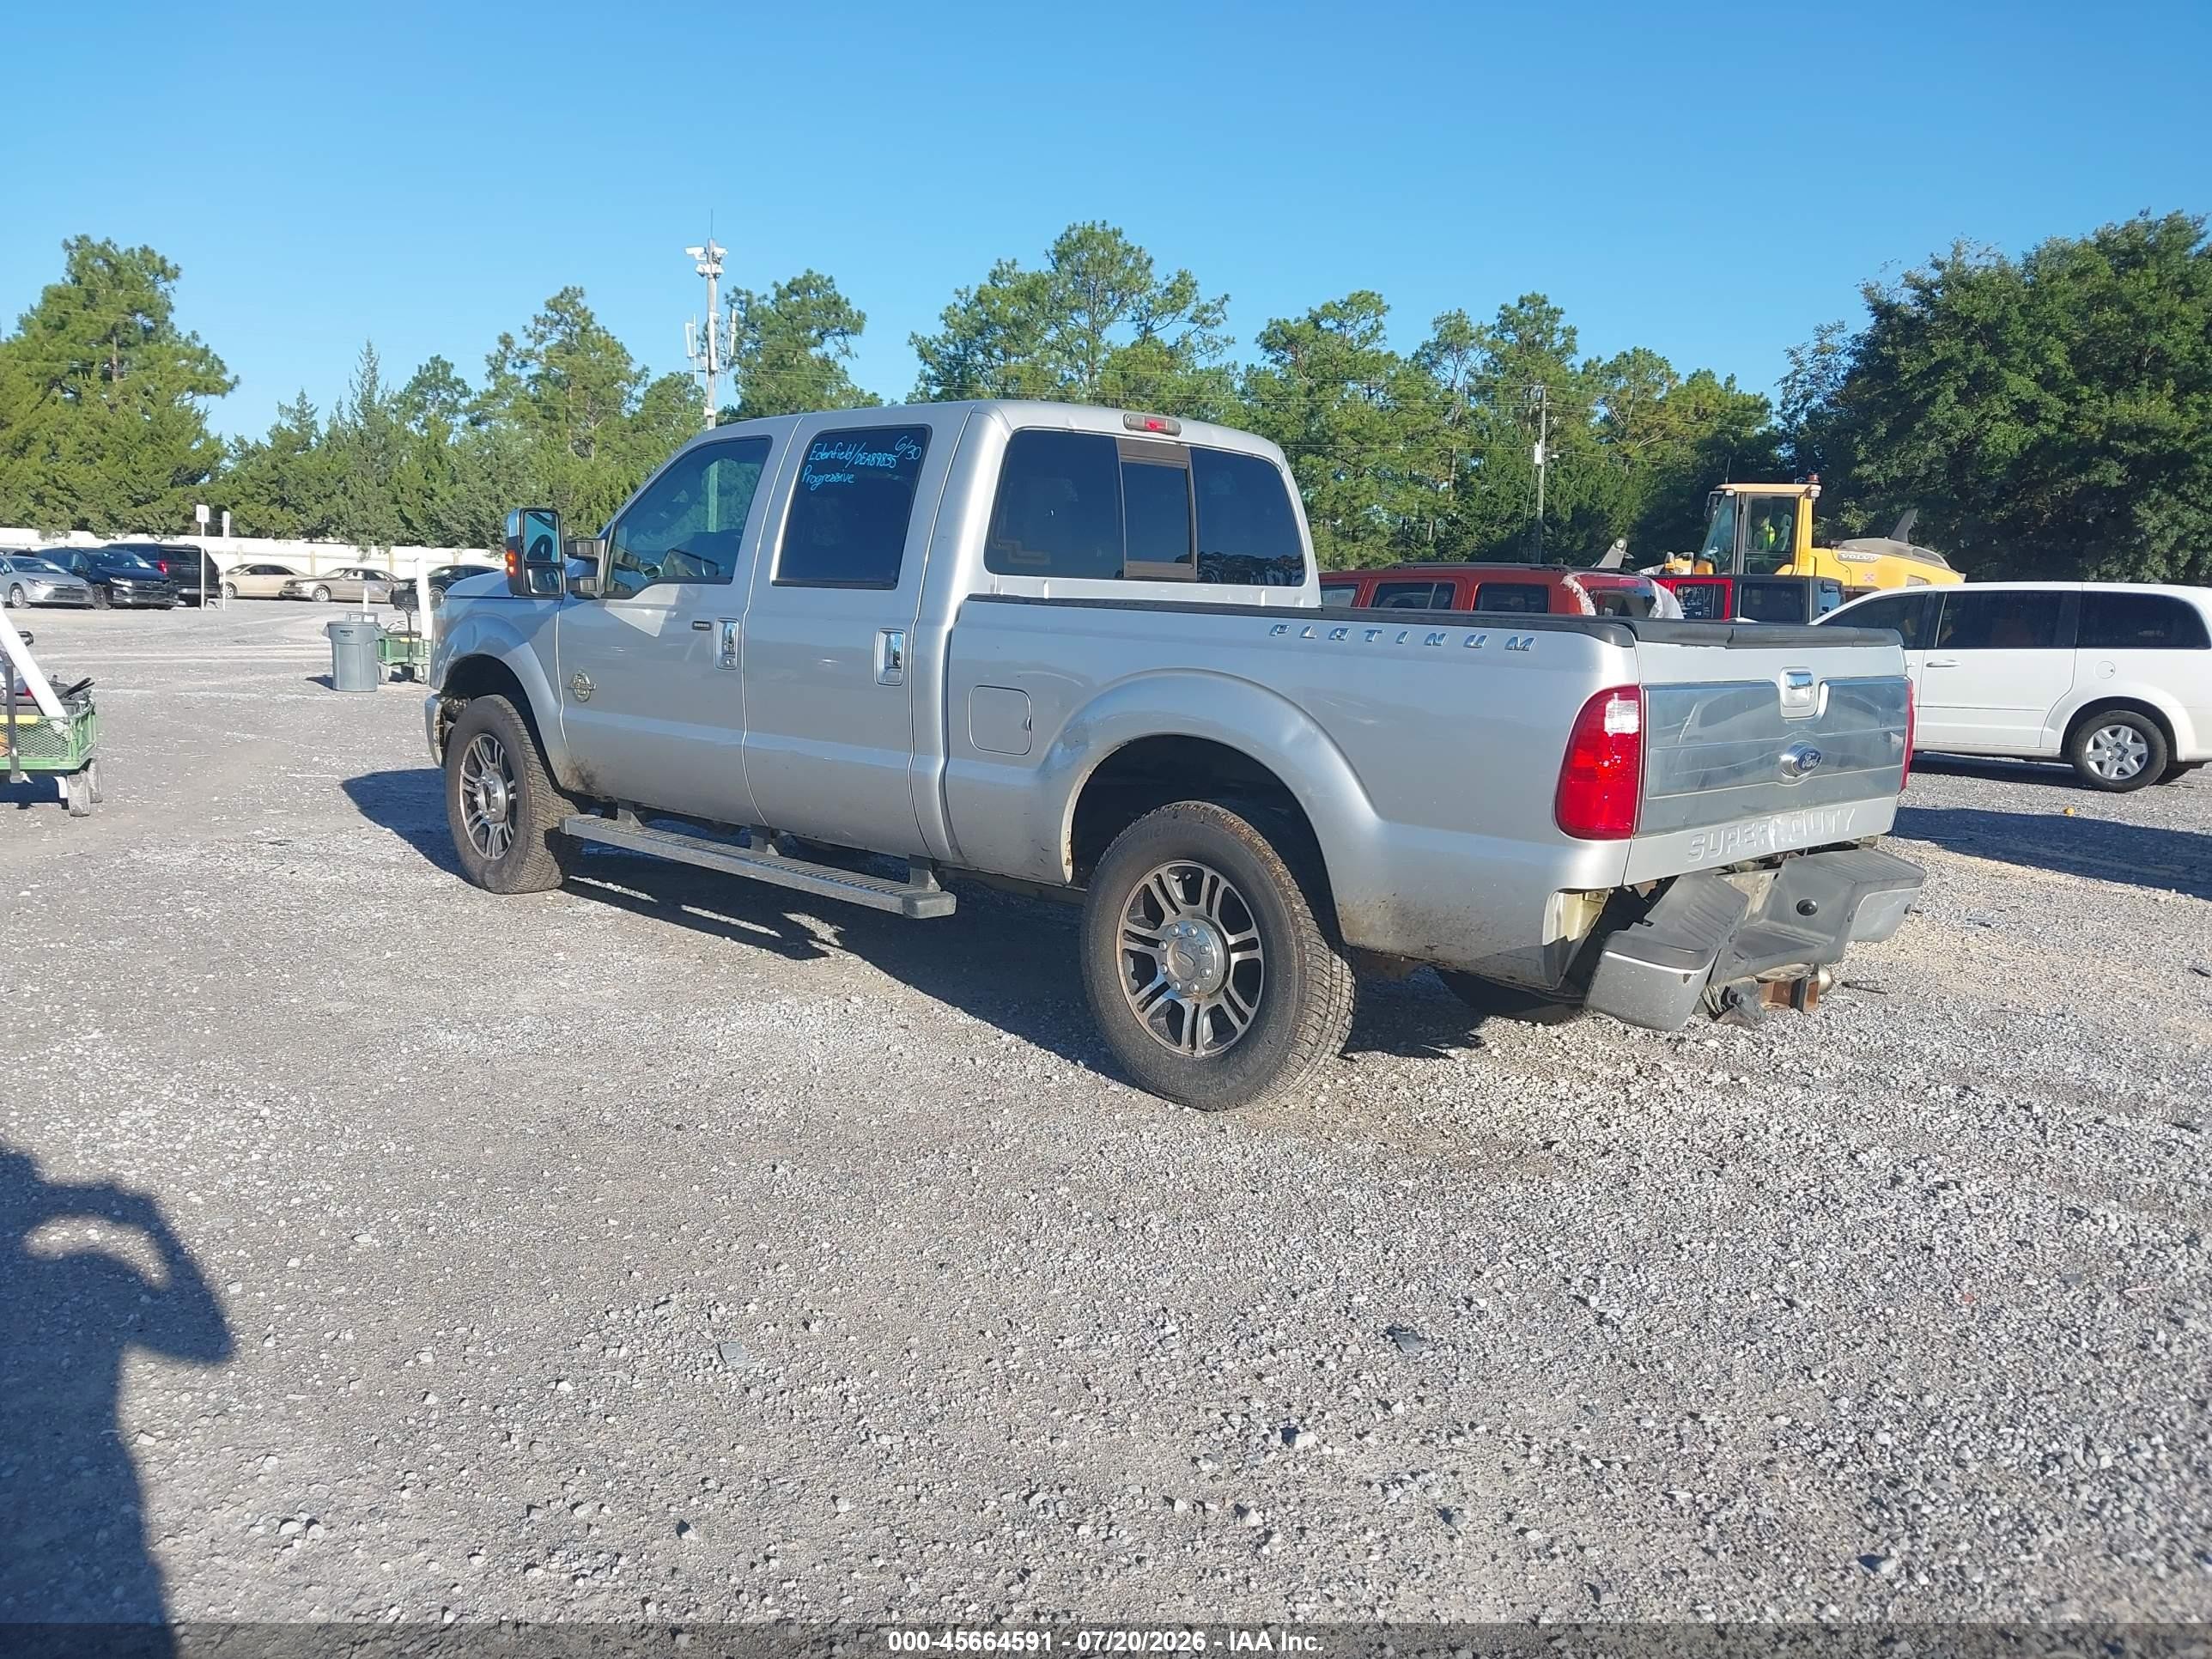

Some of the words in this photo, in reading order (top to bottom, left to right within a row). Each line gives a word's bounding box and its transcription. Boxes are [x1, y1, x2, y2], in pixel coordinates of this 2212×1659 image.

[894, 435, 921, 460] 6/30
[801, 465, 856, 491] Progressive
[1840, 552, 1879, 562] VOLVO
[1268, 623, 1537, 652] PLATINUM
[1687, 817, 1775, 863] SUPER
[1790, 808, 1856, 840] DUTY
